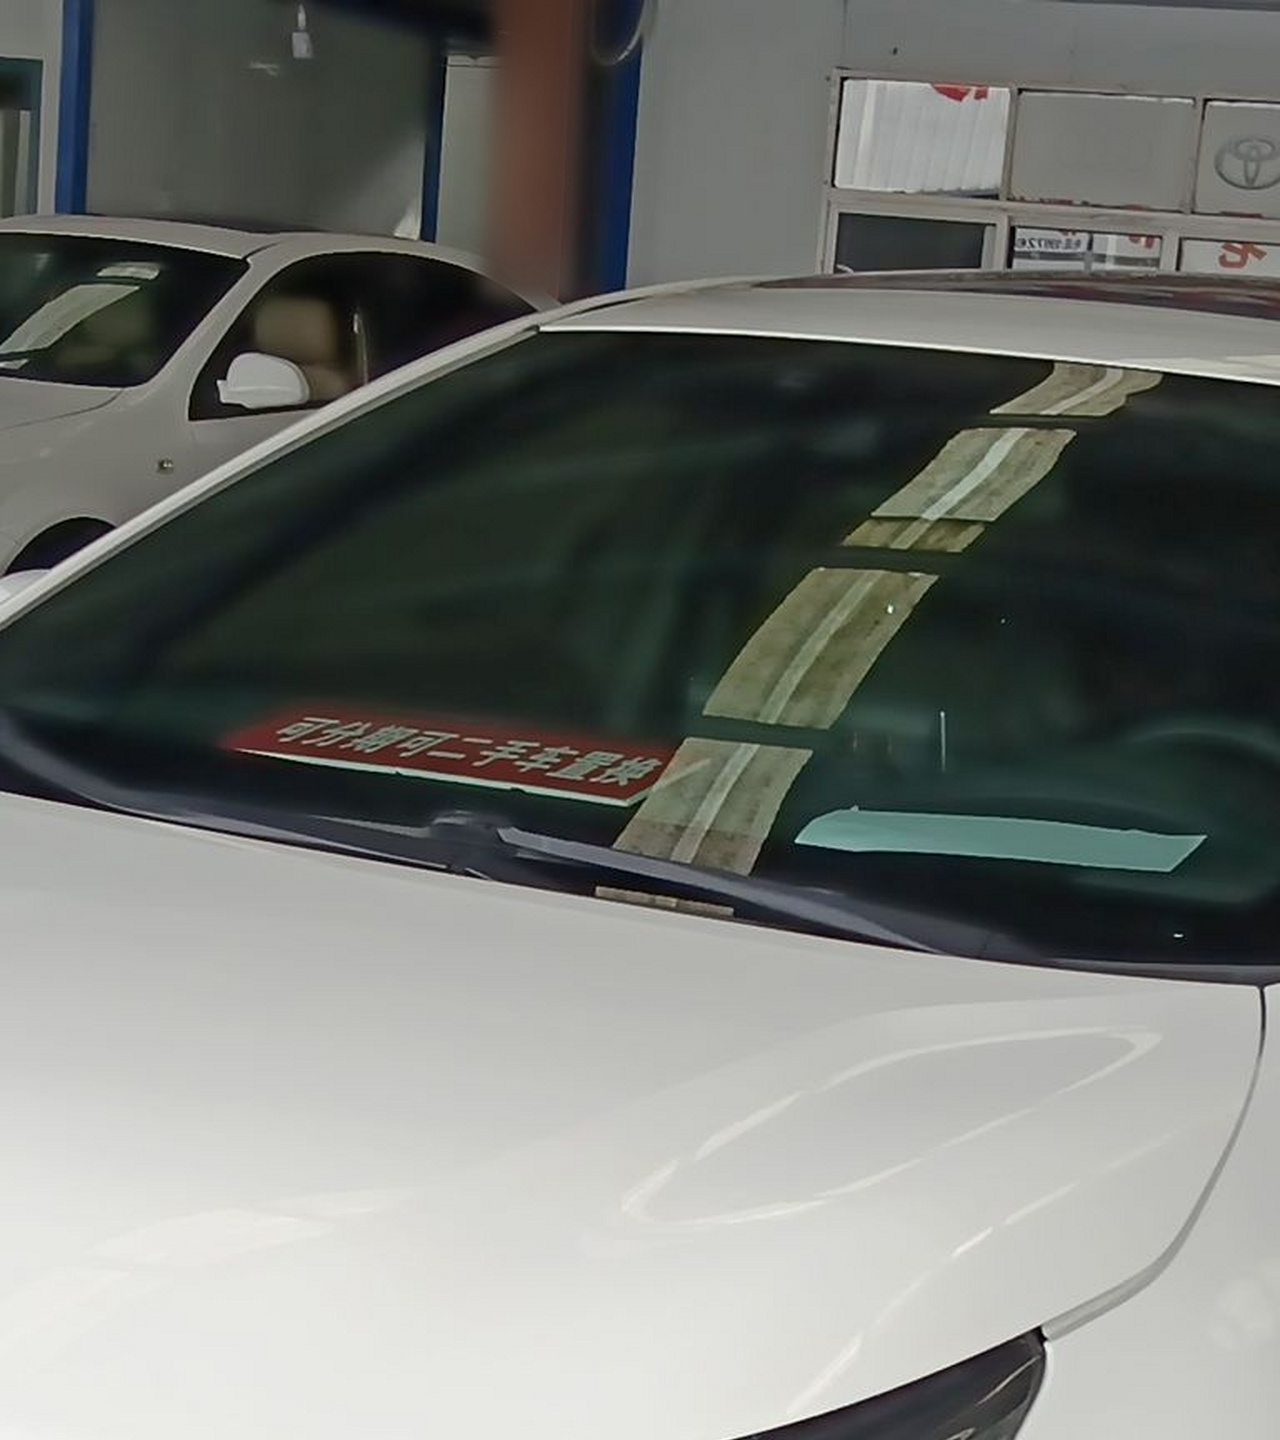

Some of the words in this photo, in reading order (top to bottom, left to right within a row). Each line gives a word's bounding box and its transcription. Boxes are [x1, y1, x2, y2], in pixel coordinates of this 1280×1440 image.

[276, 716, 663, 785] 可分期可二手车置换
